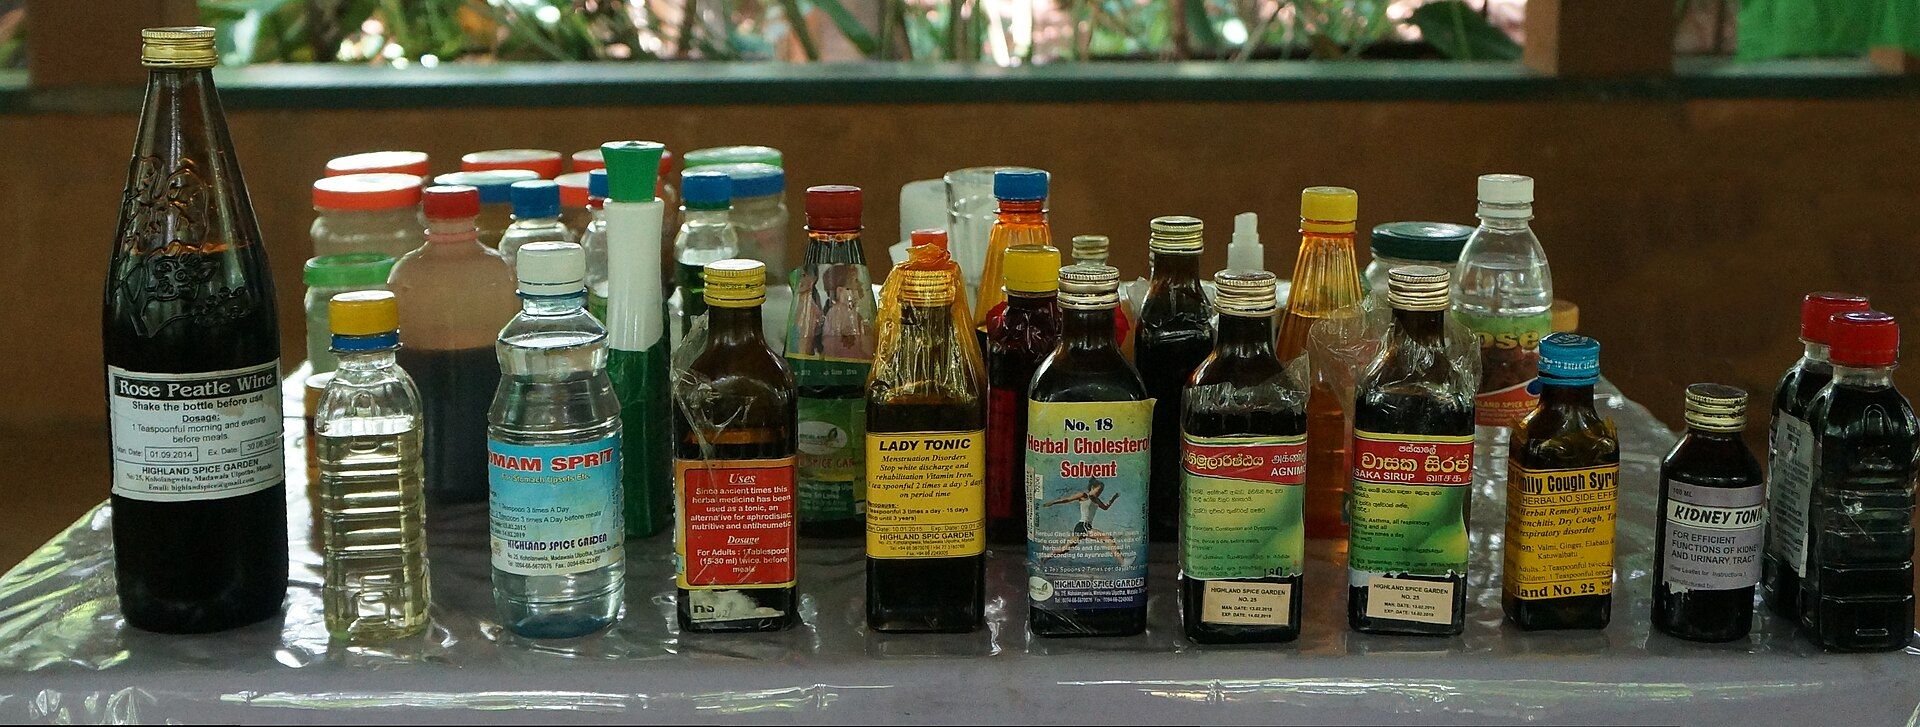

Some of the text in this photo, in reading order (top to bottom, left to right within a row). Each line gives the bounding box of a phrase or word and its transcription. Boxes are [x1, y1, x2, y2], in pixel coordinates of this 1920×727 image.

[119, 373, 273, 398] Rose Peatle Wine
[132, 394, 264, 411] Shake the bottle before use
[182, 414, 220, 423] Dosage:
[137, 415, 267, 434] Teaspoonful morning and evening
[1064, 418, 1113, 431] No. 18
[172, 435, 201, 443] before
[1027, 434, 1150, 454] Herbal Cholesterol
[879, 438, 971, 451] LADY TONIC
[149, 451, 193, 459] 01.09.2014
[550, 448, 614, 472] SPRIT
[881, 454, 966, 463] Menstruation Disorders
[142, 459, 259, 475] HIGHLAND SPICE GARDEN
[879, 464, 896, 472] Stop
[919, 463, 953, 472] discharge
[1060, 460, 1117, 478] Solvent
[728, 473, 756, 485] Uses
[926, 472, 954, 480] Vitamin
[1383, 471, 1415, 481] SIRUP
[882, 482, 915, 490] spoonful
[949, 481, 962, 489] day
[964, 479, 968, 487] 3
[1547, 474, 1586, 492] Cough
[695, 487, 718, 495] Since
[719, 486, 749, 495] ancient
[773, 485, 788, 493] this
[910, 490, 934, 499] period
[719, 495, 755, 503] medicine
[756, 495, 771, 503] has
[772, 494, 791, 502] been
[1522, 496, 1558, 505] HERBAL
[1559, 495, 1573, 503] NO
[1575, 493, 1596, 502] SIDE
[745, 504, 767, 513] tonic,
[1520, 504, 1611, 517] Herbal Remedy against
[690, 513, 744, 521] alternative for
[1674, 504, 1732, 525] KIDNEY
[691, 522, 725, 530] nutritive
[1557, 515, 1604, 527] Dry Cough,
[941, 531, 975, 540] GARDEN
[1562, 526, 1596, 536] disorder
[507, 533, 607, 551] HIGHLAND SPICE GARDEN
[727, 535, 760, 545] Dosage
[1672, 529, 1736, 545] FOR EFFICIENT
[1672, 539, 1721, 554] FUNCTIONS
[1723, 546, 1735, 554] OF
[696, 548, 710, 556] For
[711, 548, 736, 556] Adults
[1671, 549, 1756, 565] AND URINARY TRACT
[725, 557, 738, 566] ml)
[763, 556, 788, 564] before
[1548, 562, 1587, 572] Teaspoonful
[1555, 571, 1594, 579] Teaspoonful
[1054, 580, 1091, 590] HIGHLAND
[1093, 580, 1114, 589] SPICE
[1373, 583, 1404, 591] HIGHLAND
[1553, 584, 1576, 596] No.
[1580, 582, 1596, 594] 25
